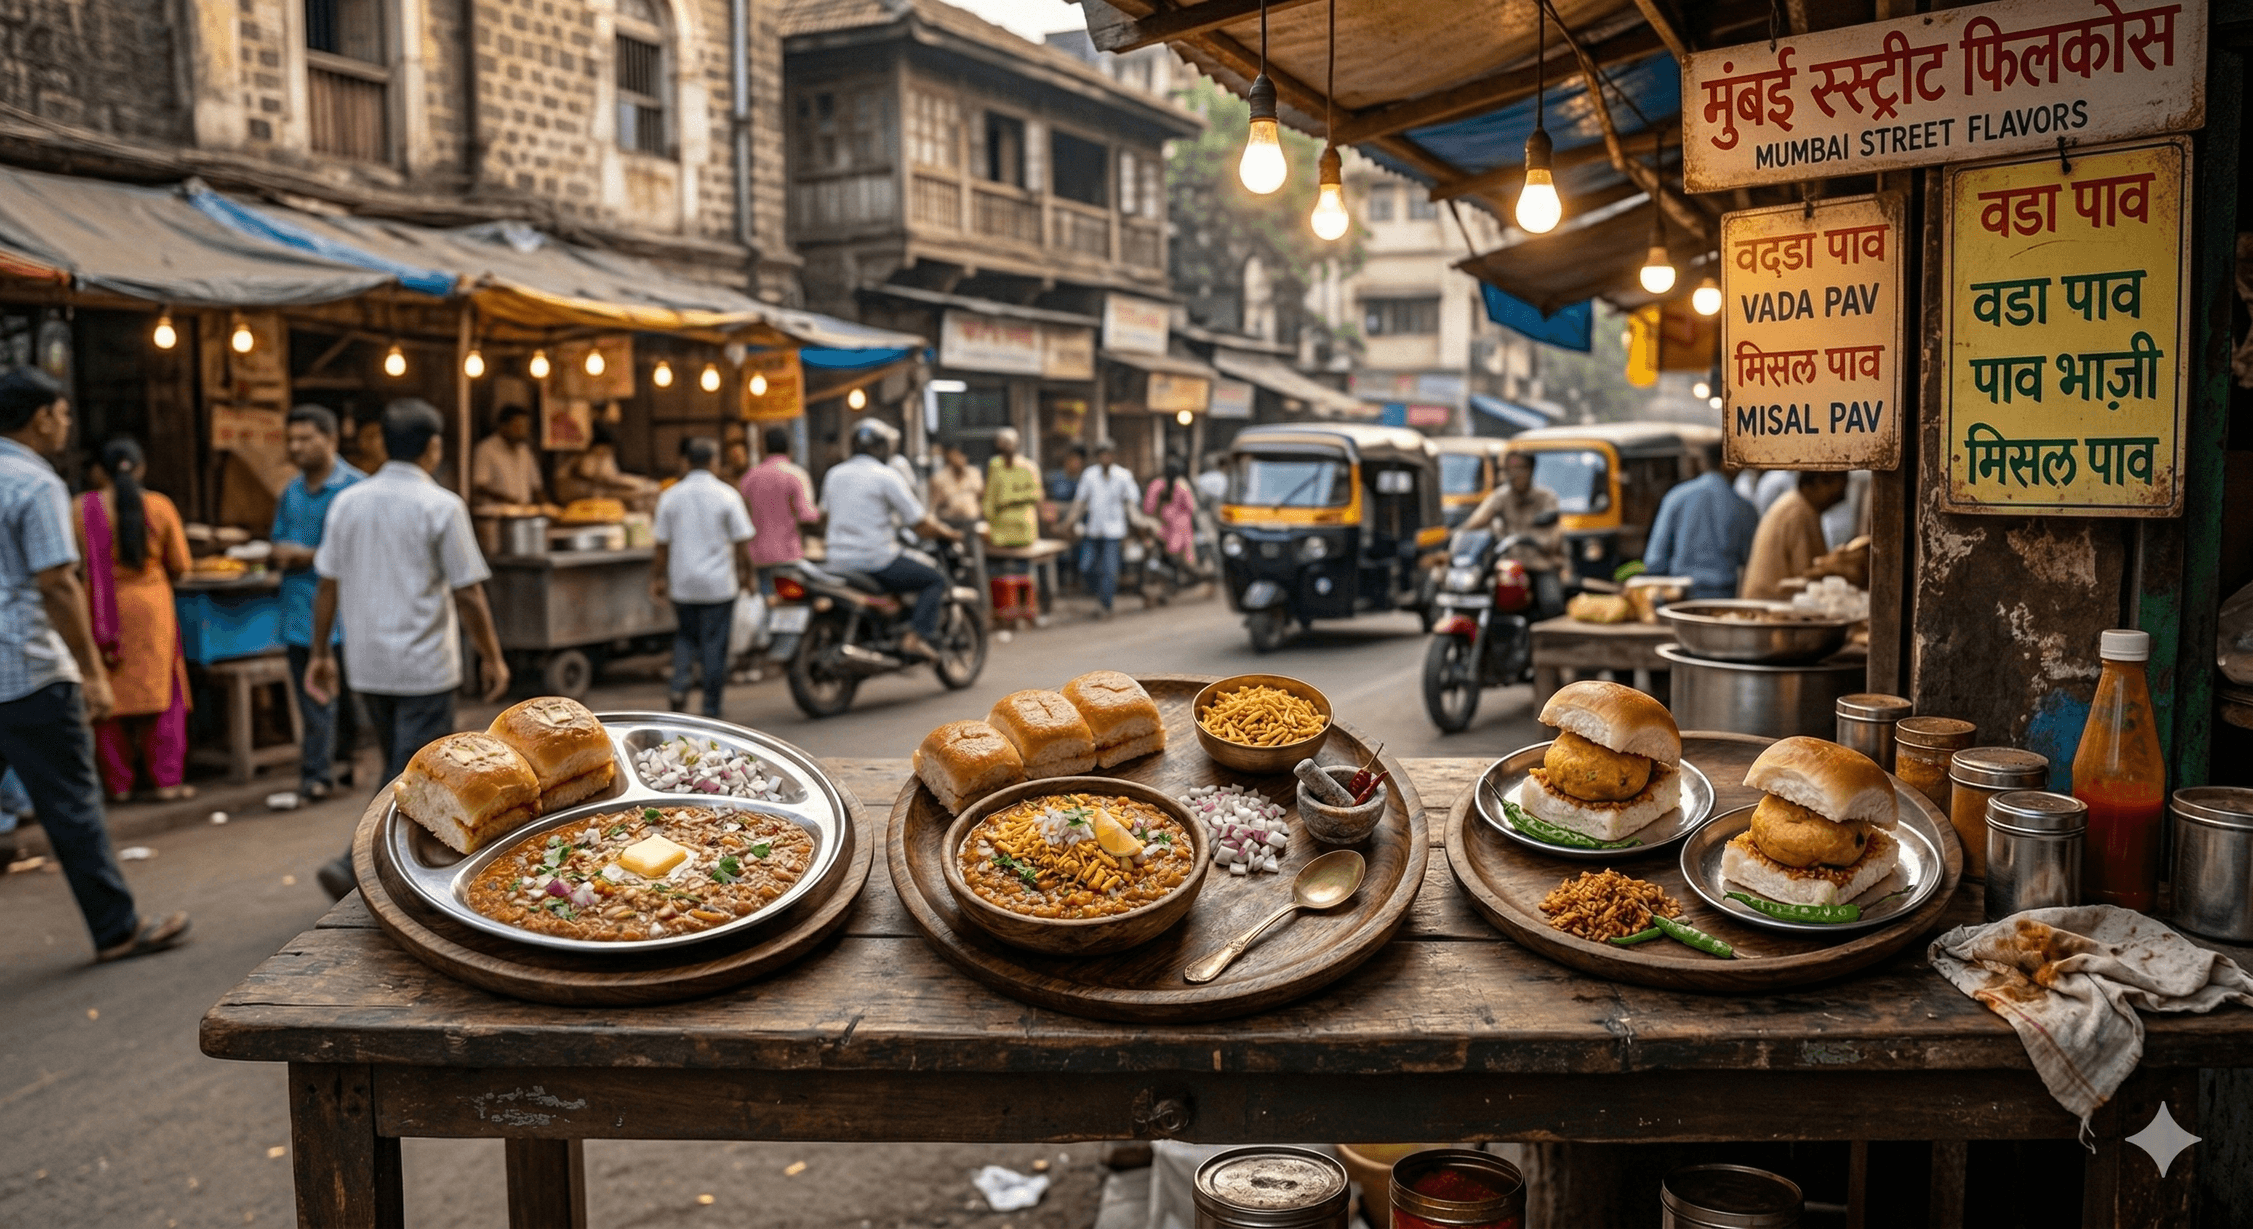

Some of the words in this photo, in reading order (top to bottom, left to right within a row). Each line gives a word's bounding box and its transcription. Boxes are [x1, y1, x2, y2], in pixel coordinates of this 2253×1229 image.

[1701, 46, 1798, 150] मुंबई
[1755, 133, 1849, 170] MUMBAI
[1859, 118, 1956, 157] STREET
[1967, 100, 2088, 143] FLAVORS
[1977, 183, 2063, 239] वडा
[2070, 172, 2156, 229] पाव
[1823, 223, 1891, 265] पाव
[1740, 288, 1815, 324] VADA
[1824, 282, 1880, 318] PAV
[1970, 277, 2052, 328] वडा
[2061, 269, 2147, 322] पाव
[1734, 340, 1819, 388] मिसल
[1824, 345, 1886, 382] पाव
[1968, 356, 2047, 405] पाव
[1736, 403, 1819, 438] MISAL
[1829, 400, 1884, 434] PAV
[1963, 422, 2079, 488] मिसल
[2084, 437, 2160, 488] पाव
